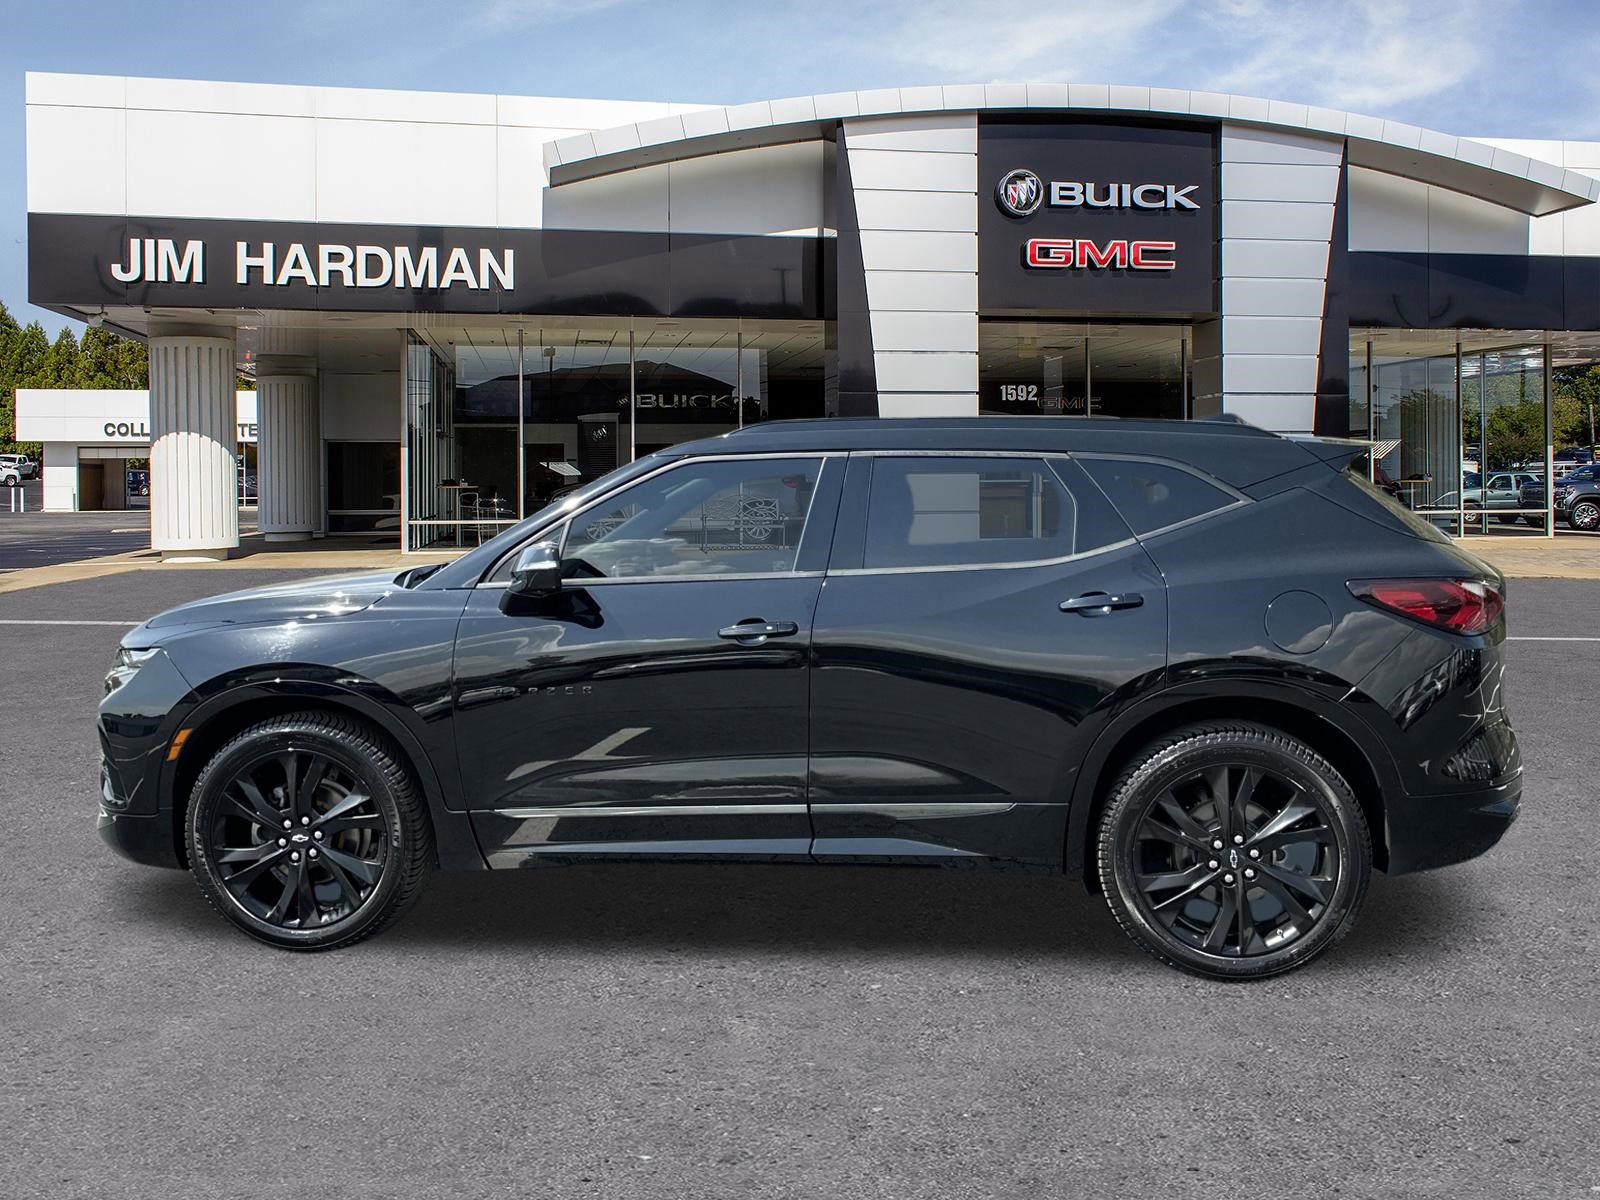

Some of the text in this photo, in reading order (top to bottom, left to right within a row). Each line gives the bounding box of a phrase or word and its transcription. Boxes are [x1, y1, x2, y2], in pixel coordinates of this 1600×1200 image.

[1050, 181, 1200, 209] BUICK
[111, 238, 515, 291] JIM HARDMAN
[1026, 238, 1176, 270] GMC
[636, 394, 731, 409] BUICK
[1000, 385, 1038, 401] 1592
[104, 422, 150, 437] COLL
